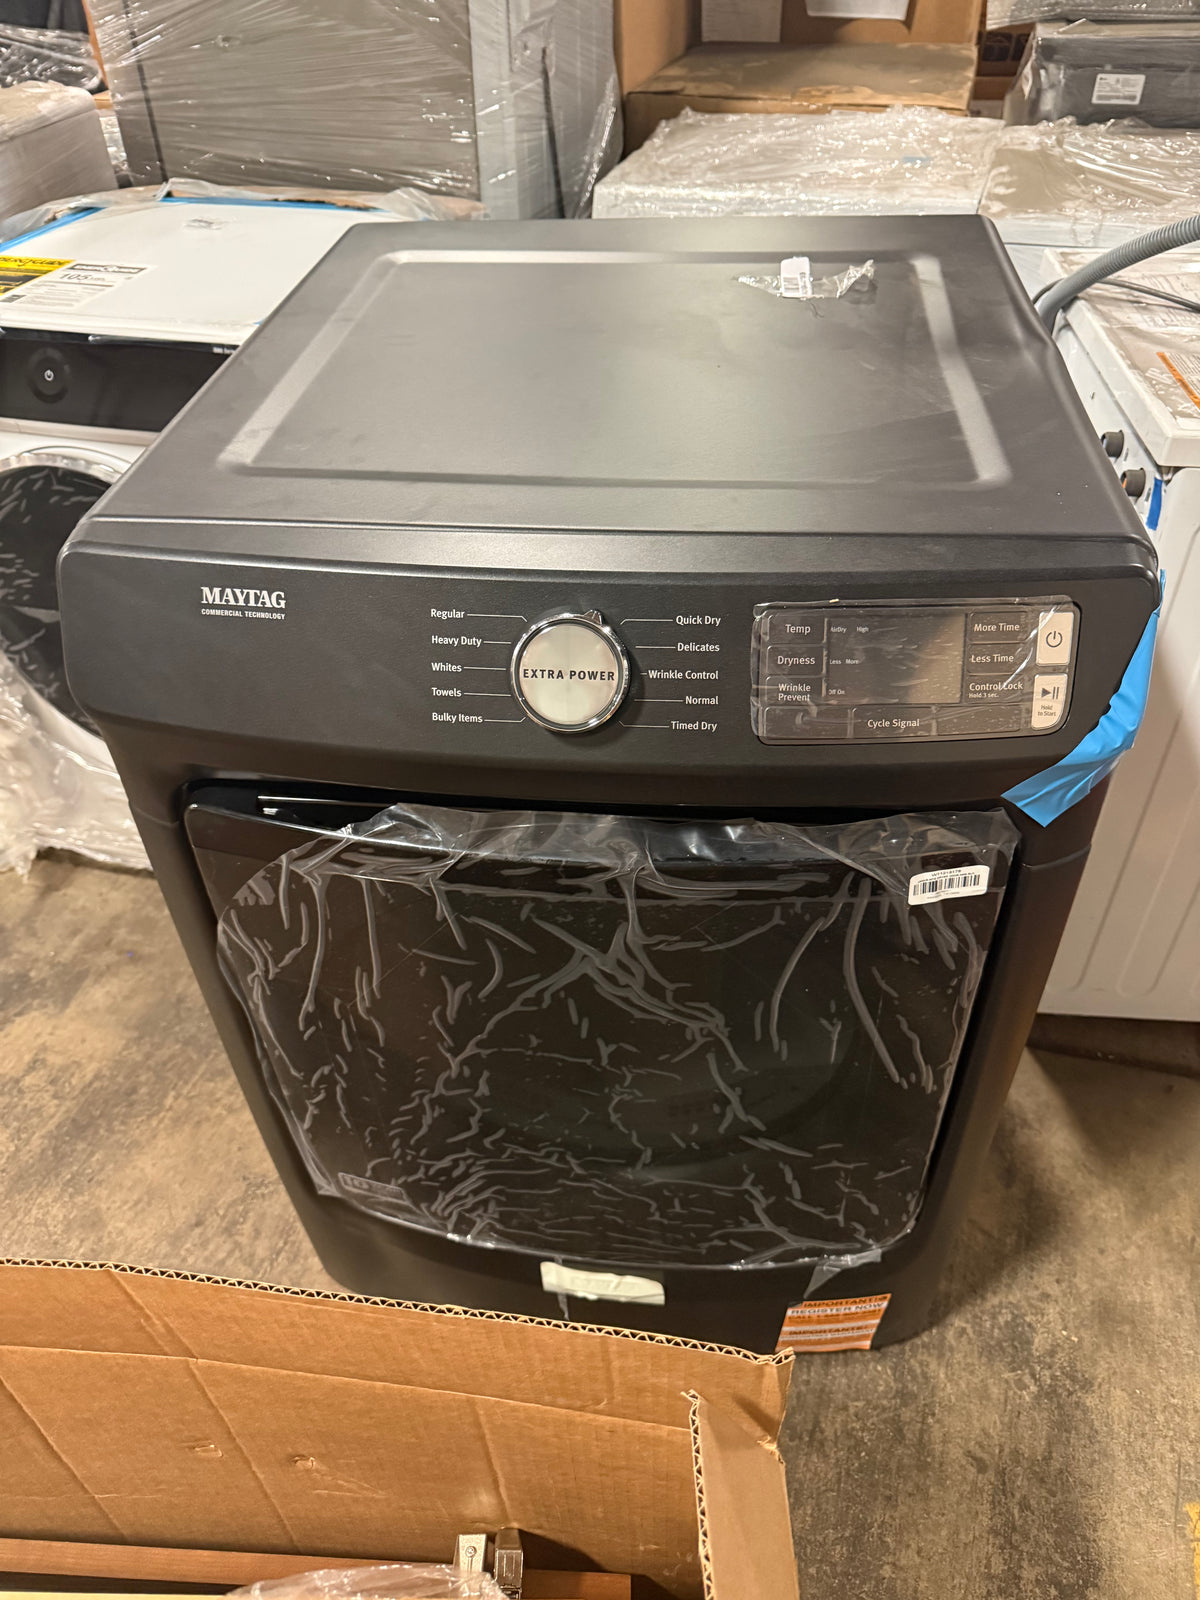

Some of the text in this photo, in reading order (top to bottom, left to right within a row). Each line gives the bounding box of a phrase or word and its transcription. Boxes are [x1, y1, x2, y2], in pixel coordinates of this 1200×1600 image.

[200, 586, 287, 609] MAYTAG
[201, 608, 286, 620] COMMERCIAL TECHNOLOGY
[430, 608, 465, 620] Regular
[675, 615, 721, 627] Quick Dry
[785, 624, 811, 635] Temp
[973, 623, 1020, 632] More Time
[431, 635, 482, 648] Heavy Duty
[677, 642, 720, 652] Delicates
[777, 655, 816, 667] Dryness
[971, 653, 1015, 663] Less Time
[431, 662, 462, 673] Whites
[523, 668, 615, 681] EXTRA POWER
[648, 669, 719, 680] Wrinkle Control
[431, 687, 462, 697] Towels
[778, 683, 812, 693] Wrinkle
[969, 682, 1002, 692] Control
[685, 695, 719, 705] Normal
[778, 693, 810, 702] Prevent
[431, 712, 484, 724] Bulky Items
[867, 718, 920, 729] Cycle Signal
[670, 720, 718, 733] Timed Dry
[791, 1307, 852, 1315] REGISTER
[854, 1302, 885, 1311] NOW
